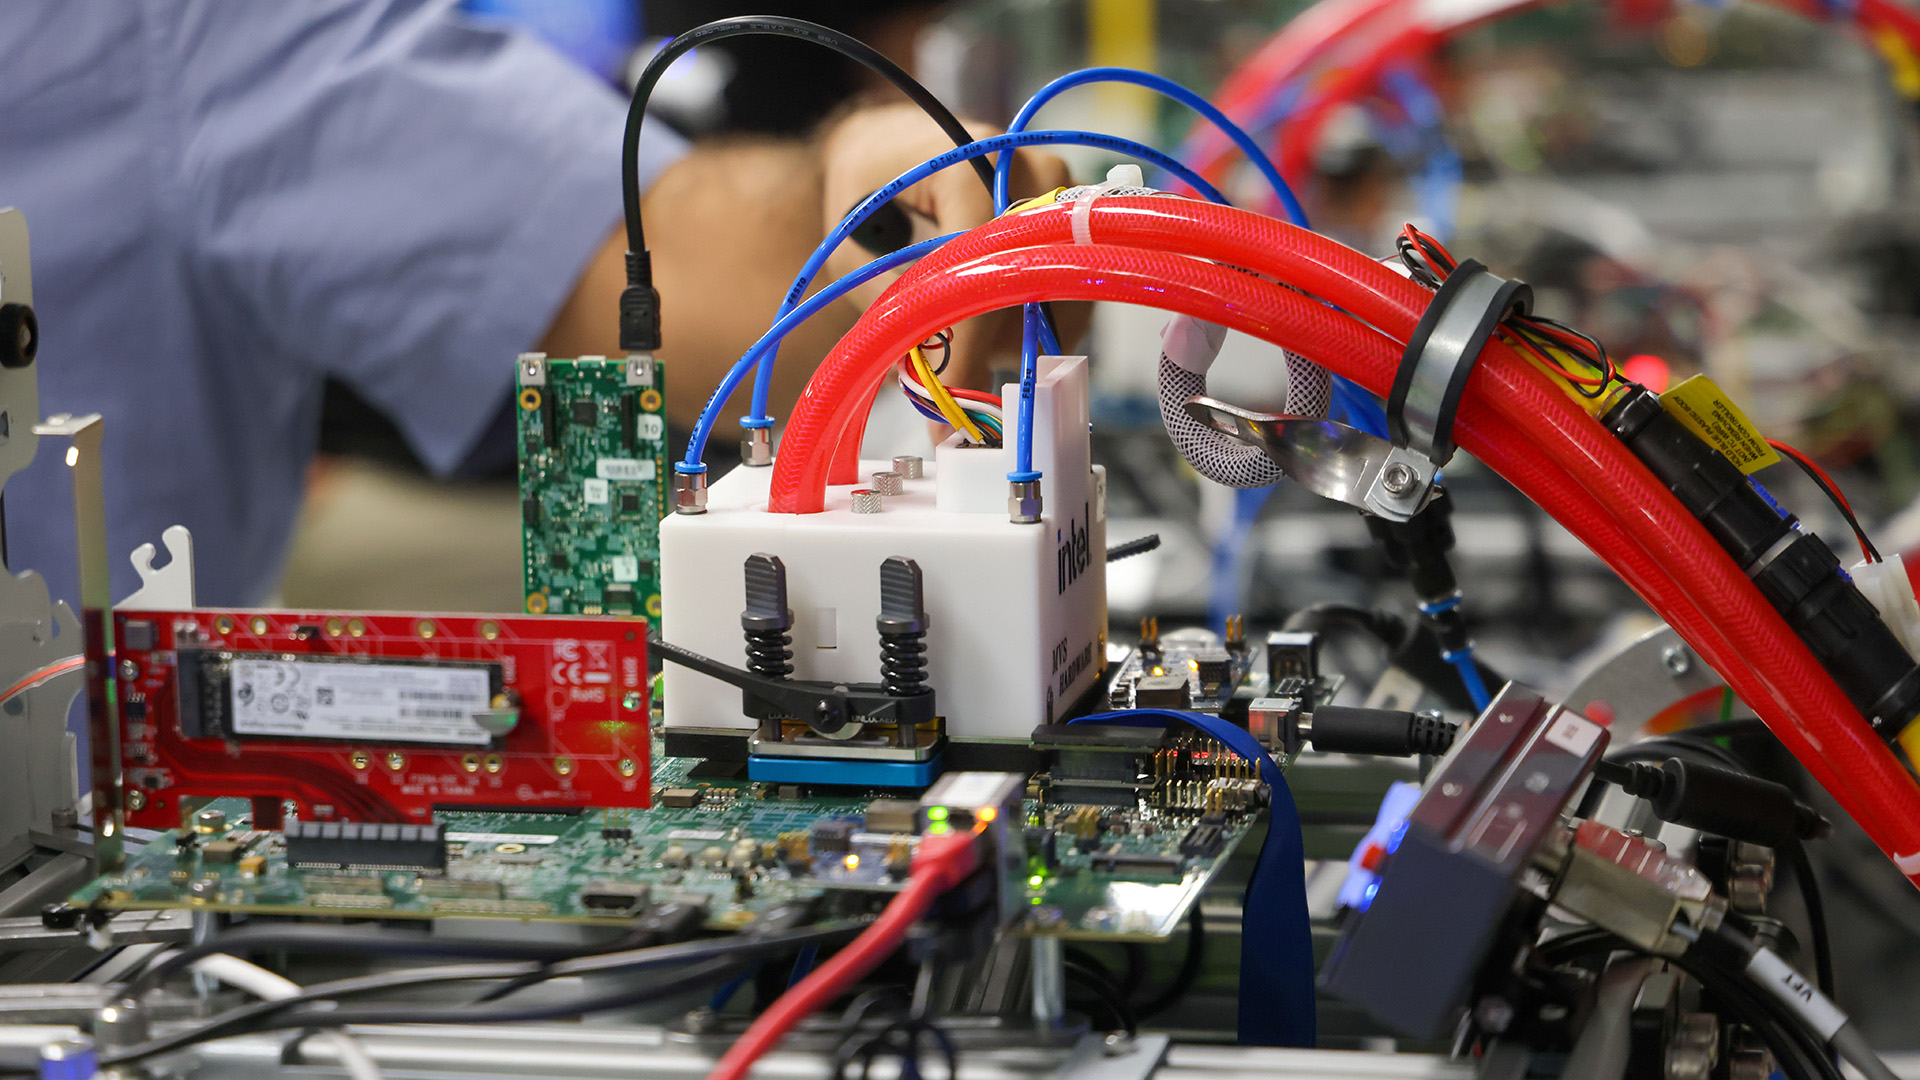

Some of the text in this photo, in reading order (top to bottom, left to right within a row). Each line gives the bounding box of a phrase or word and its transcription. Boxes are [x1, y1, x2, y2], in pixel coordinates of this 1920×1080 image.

[750, 23, 784, 31] CABLE
[787, 276, 807, 305] FESTO
[1022, 368, 1032, 399] FESTO
[644, 424, 659, 434] 10
[1672, 396, 1744, 468] HOLD BLUE PLASTIC BODY
[1711, 421, 1730, 440] WIRE)
[1711, 410, 1759, 460] WHEN REMOVING
[1712, 399, 1766, 457] FROM CONTROLLER
[1734, 447, 1752, 465] (NOT
[1057, 502, 1091, 595] intel
[652, 637, 708, 662] LOCKED
[1059, 642, 1092, 697] HARDWARE
[1780, 972, 1813, 1003] VFT
